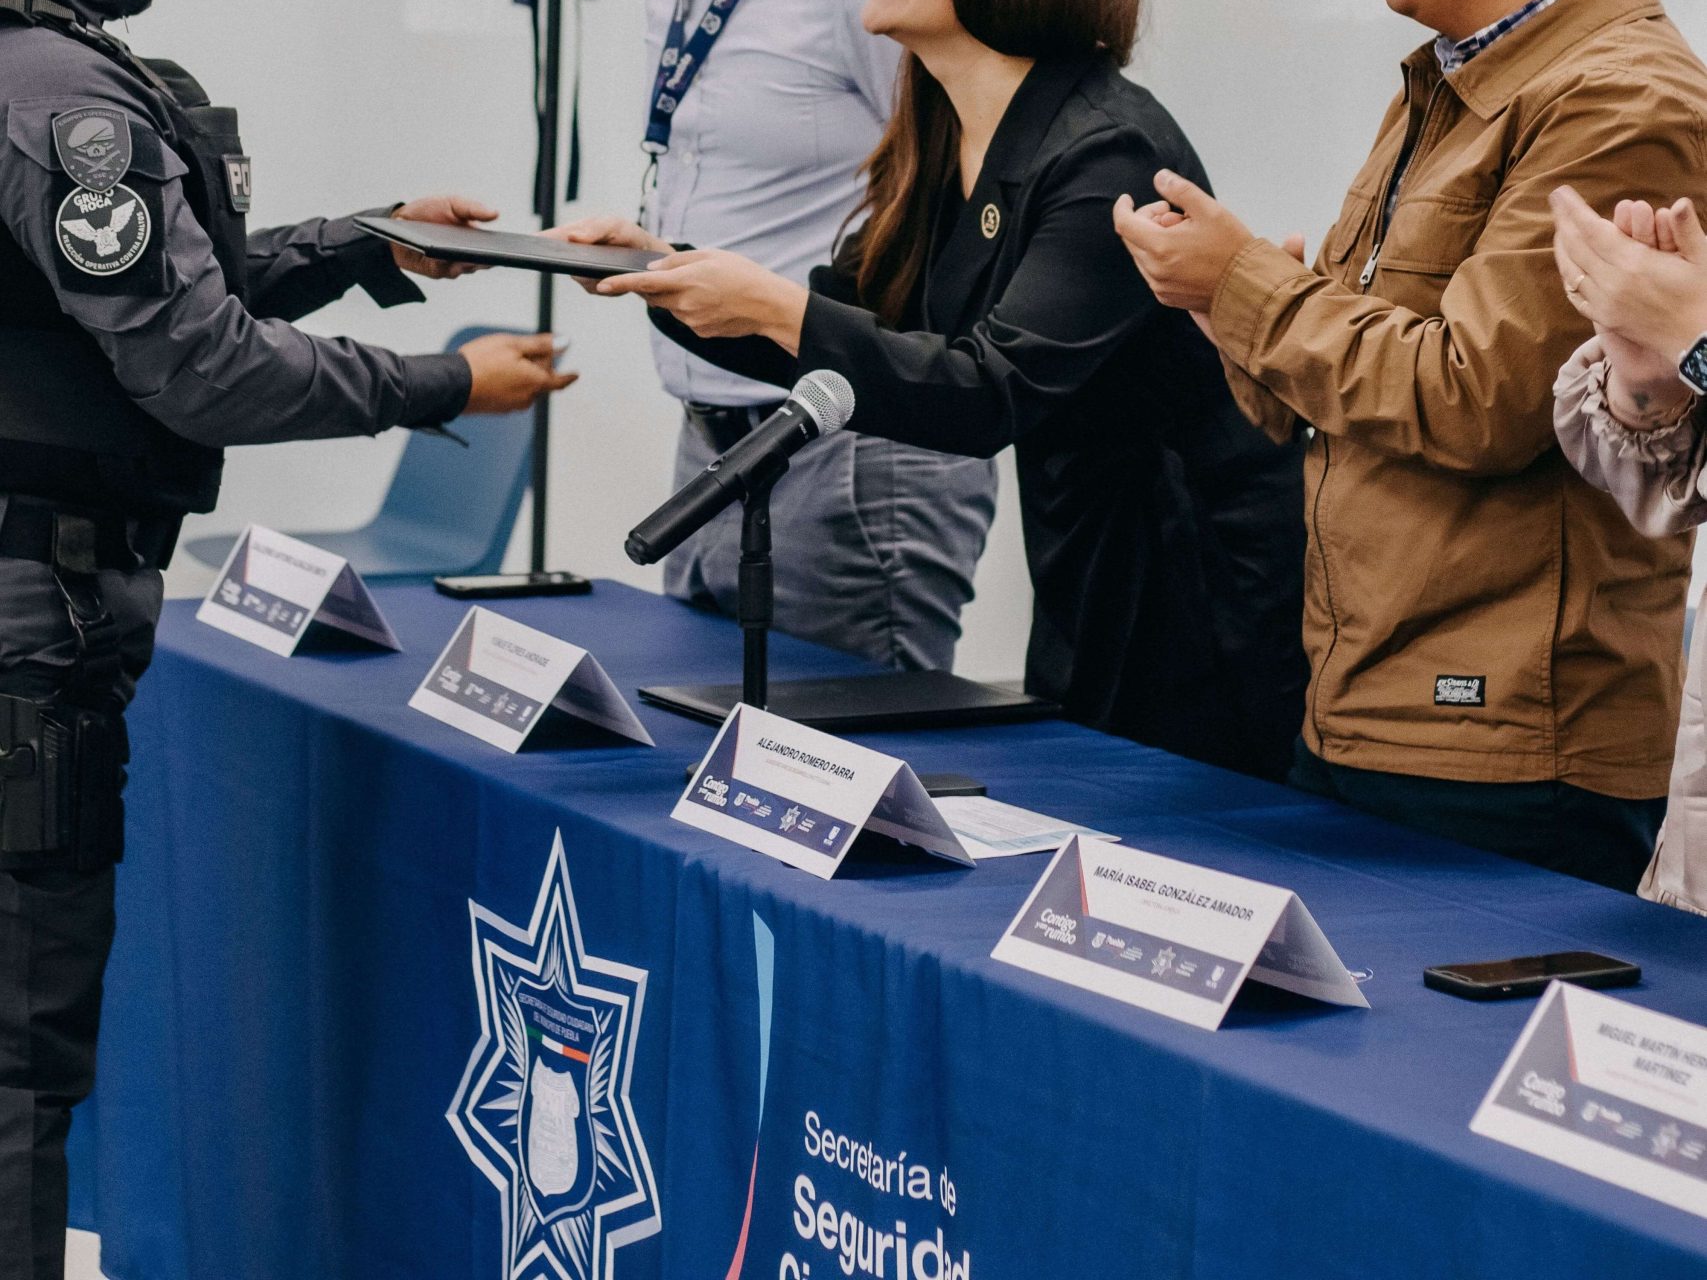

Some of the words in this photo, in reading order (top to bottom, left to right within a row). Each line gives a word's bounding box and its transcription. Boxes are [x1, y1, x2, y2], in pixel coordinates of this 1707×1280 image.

[73, 188, 115, 207] GRUO
[80, 197, 113, 214] ROCA
[84, 260, 121, 270] OPERATIVA
[119, 241, 142, 264] CONTRA
[136, 211, 146, 242] ASALTOS
[757, 737, 800, 760] ALEJANDRO
[799, 752, 831, 771] ROMERO
[828, 763, 855, 781] PARRA
[1093, 865, 1124, 883] MARÍA
[1124, 875, 1157, 893] ISABEL
[1158, 884, 1211, 909] GONZÁLEZ
[1210, 899, 1254, 921] AMADOR
[1041, 908, 1077, 932] Contigo
[1044, 926, 1077, 945] rumbo
[1597, 1023, 1637, 1047] MIGUEL
[804, 1110, 933, 1200] Secretaría
[939, 1165, 957, 1217] de
